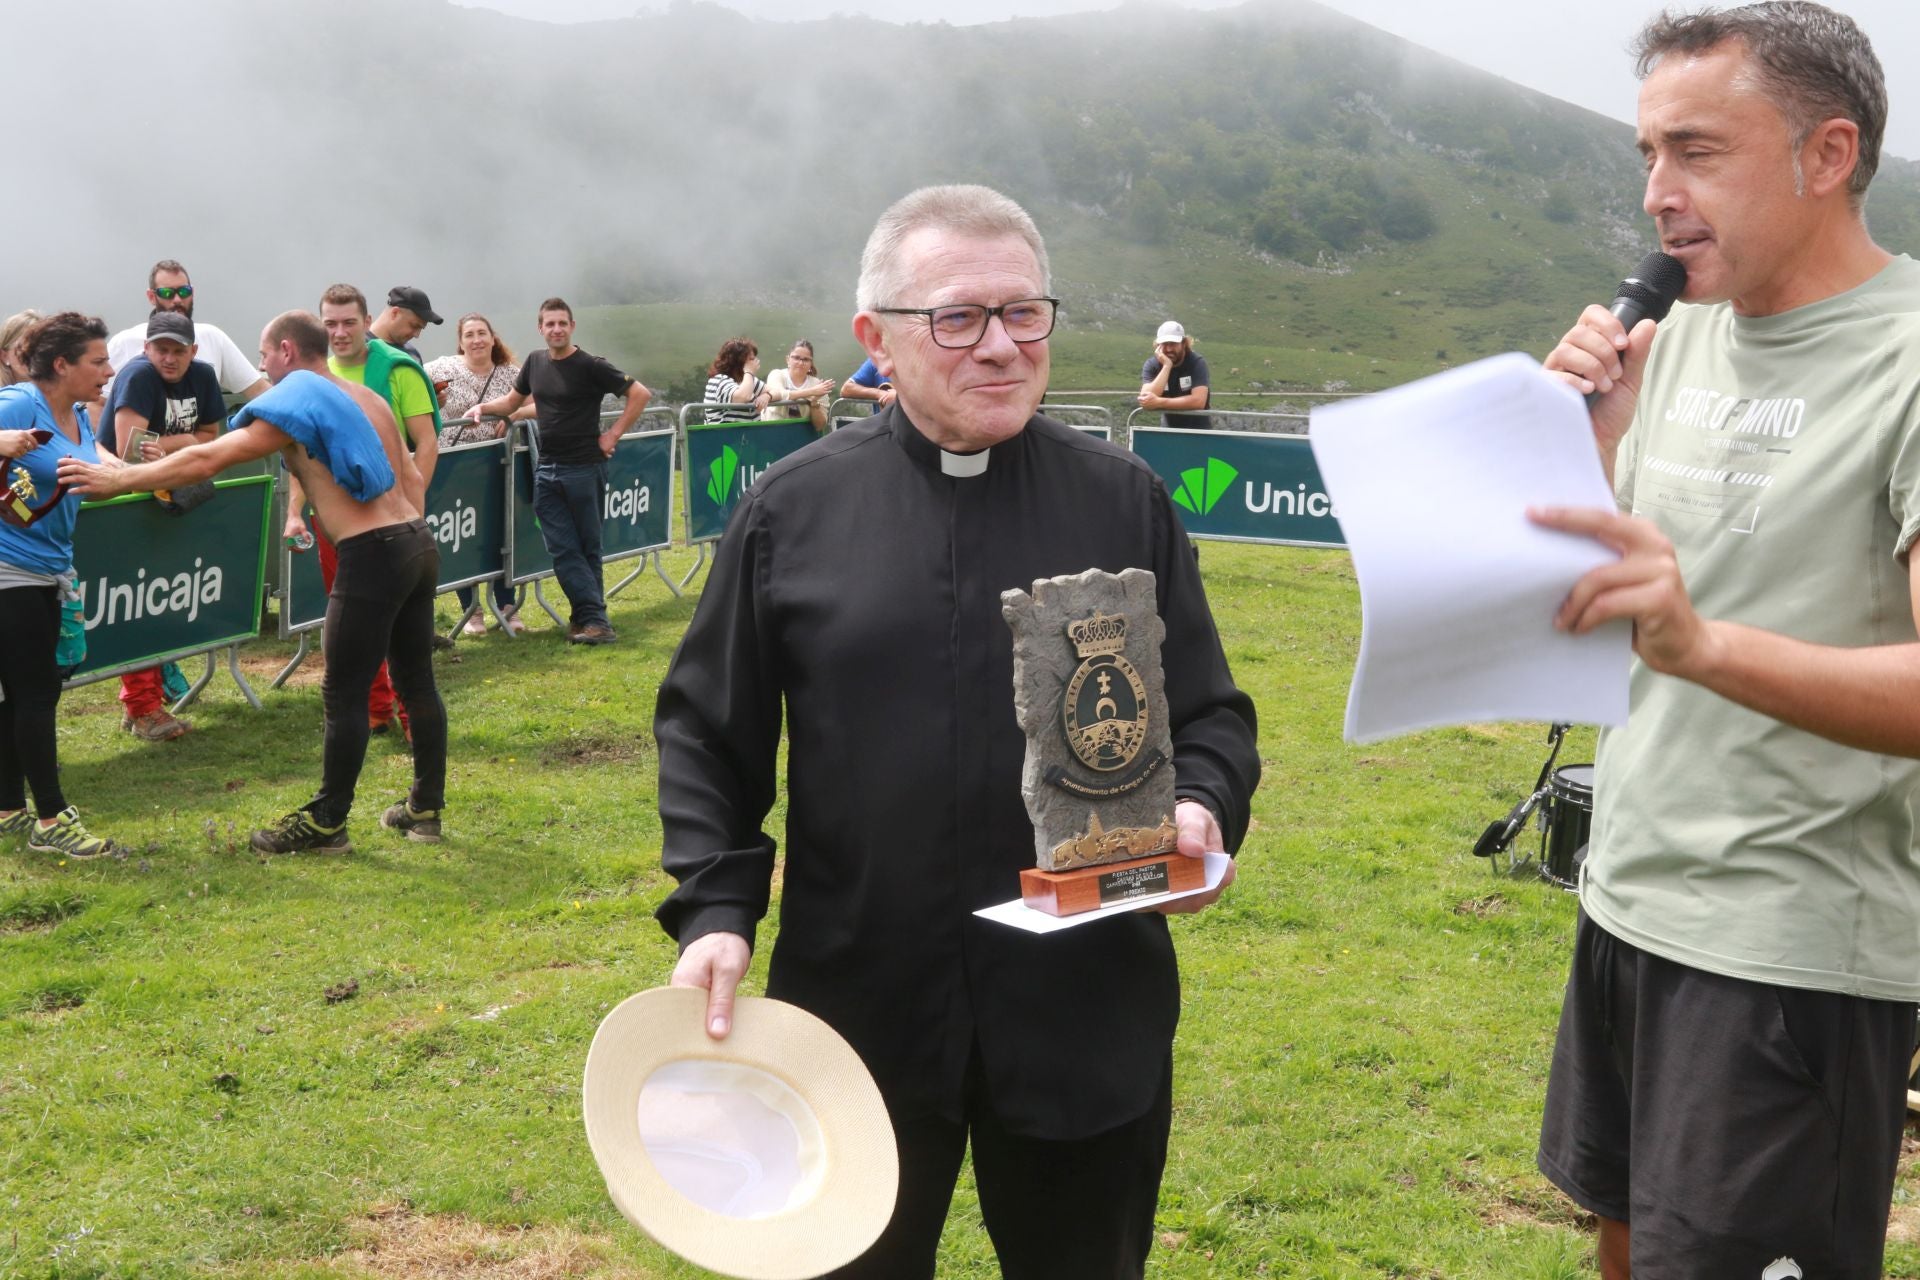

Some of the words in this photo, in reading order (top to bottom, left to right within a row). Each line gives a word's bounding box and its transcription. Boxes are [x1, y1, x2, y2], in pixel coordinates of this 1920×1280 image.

[1734, 398, 1806, 439] MIND
[604, 478, 650, 526] icaja
[1245, 481, 1341, 518] Unic
[425, 498, 476, 553] caja
[79, 557, 223, 631] Unicaja
[1061, 777, 1108, 796] Ayuntamiento
[1109, 786, 1119, 794] de
